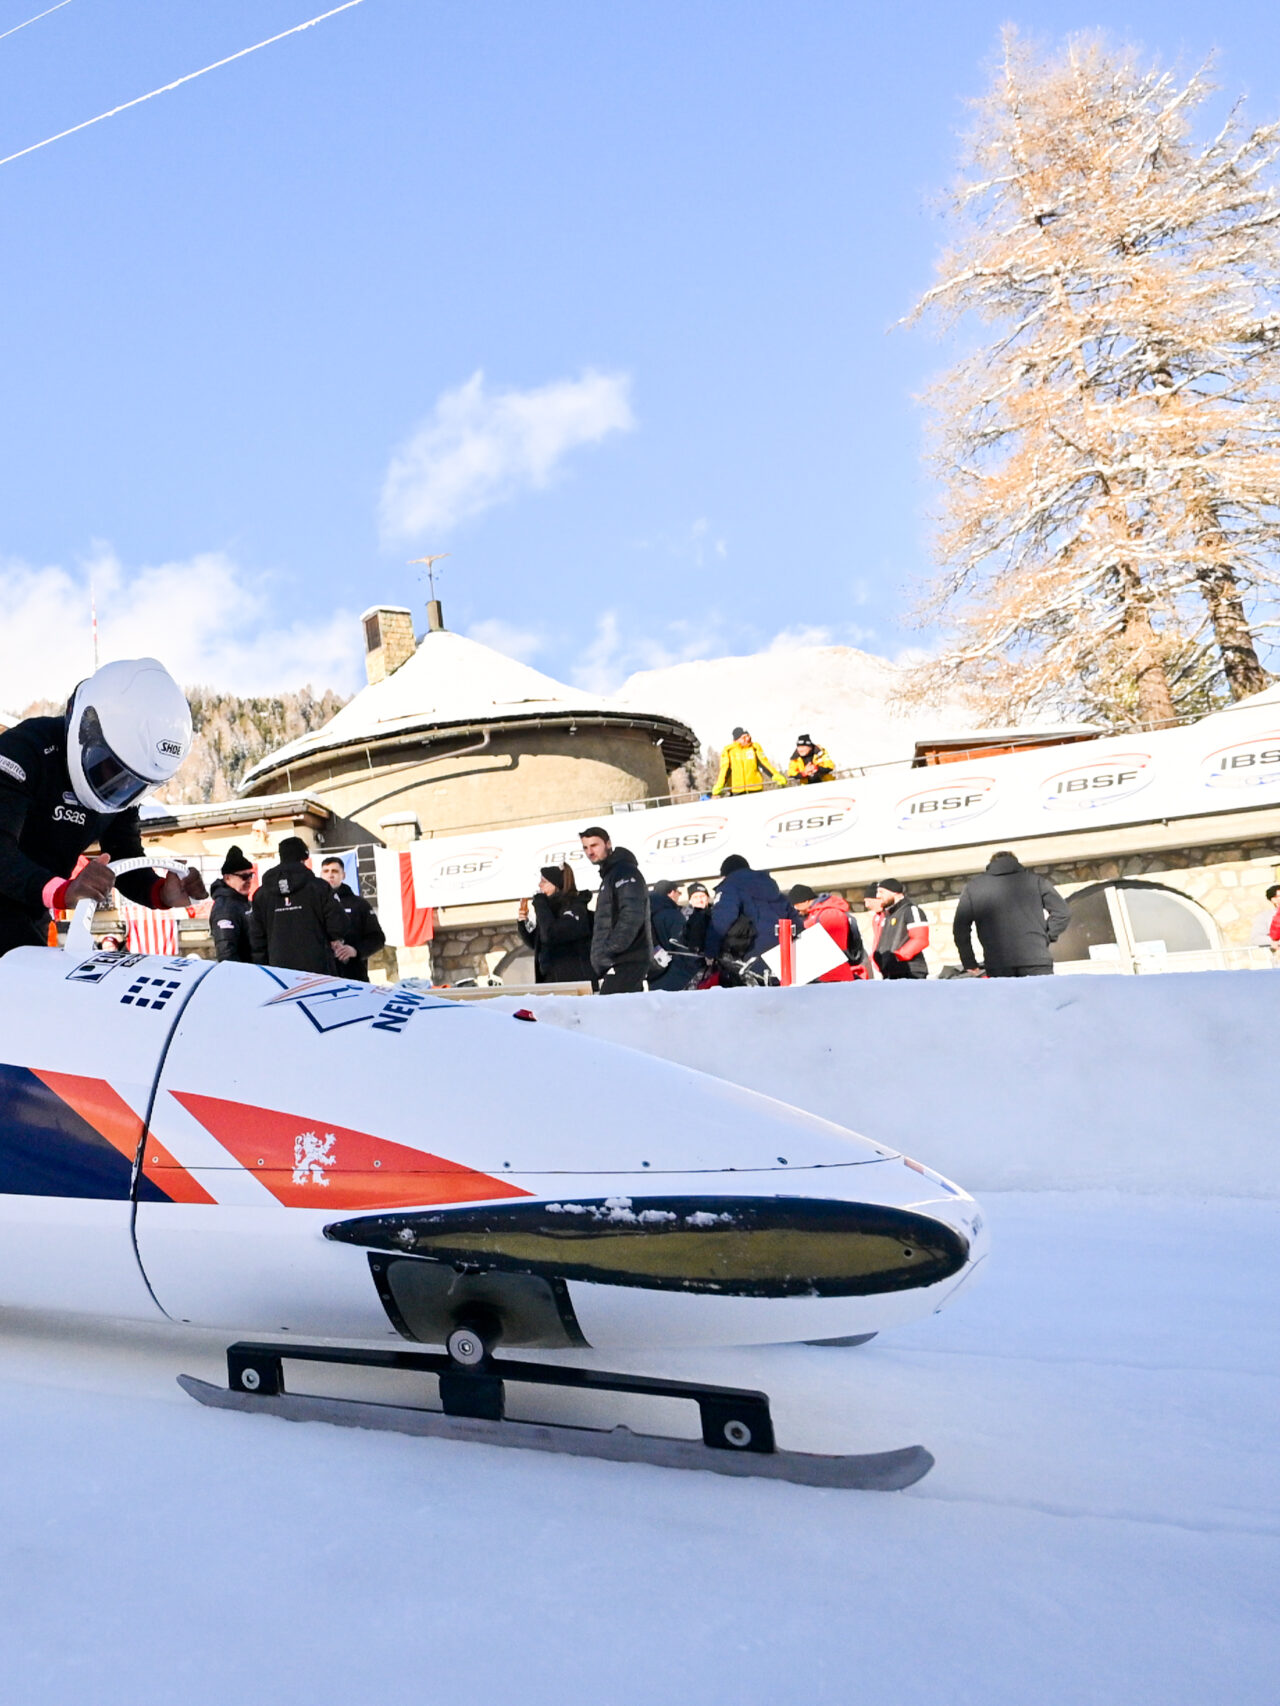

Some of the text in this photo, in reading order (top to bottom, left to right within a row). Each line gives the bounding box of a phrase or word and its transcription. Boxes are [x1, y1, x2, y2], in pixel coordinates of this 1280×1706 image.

[1056, 770, 1139, 794] IBSF
[910, 793, 983, 815] IBSF
[63, 809, 86, 826] sas
[778, 813, 844, 833] IBSF
[656, 831, 718, 850] IBSF
[439, 860, 494, 877] IBSF
